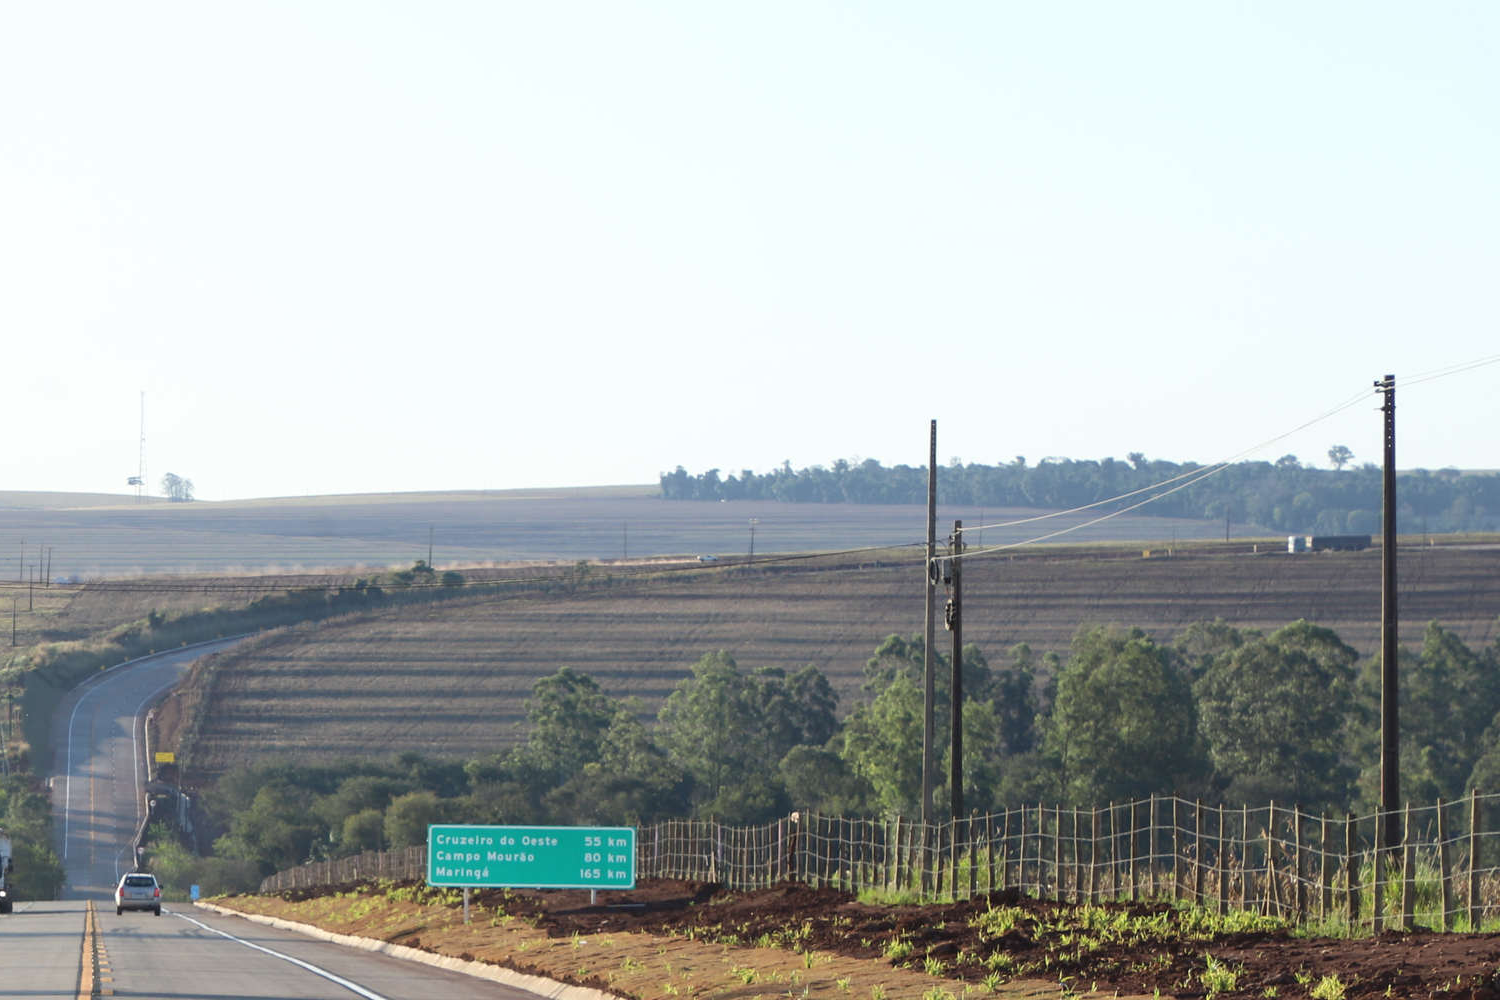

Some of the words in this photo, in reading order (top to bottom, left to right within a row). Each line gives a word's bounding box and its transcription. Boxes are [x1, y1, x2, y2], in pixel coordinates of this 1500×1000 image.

[436, 834, 493, 845] Cruzeiro
[500, 836, 515, 845] do
[522, 836, 558, 846] Oeste
[584, 836, 601, 846] 55
[607, 837, 627, 847] km
[436, 851, 480, 862] Campo
[487, 852, 534, 862] Mourão
[584, 853, 601, 862] 80
[607, 853, 627, 863] km
[436, 866, 489, 880] Maringá
[580, 869, 601, 878] 165
[607, 869, 627, 879] km
